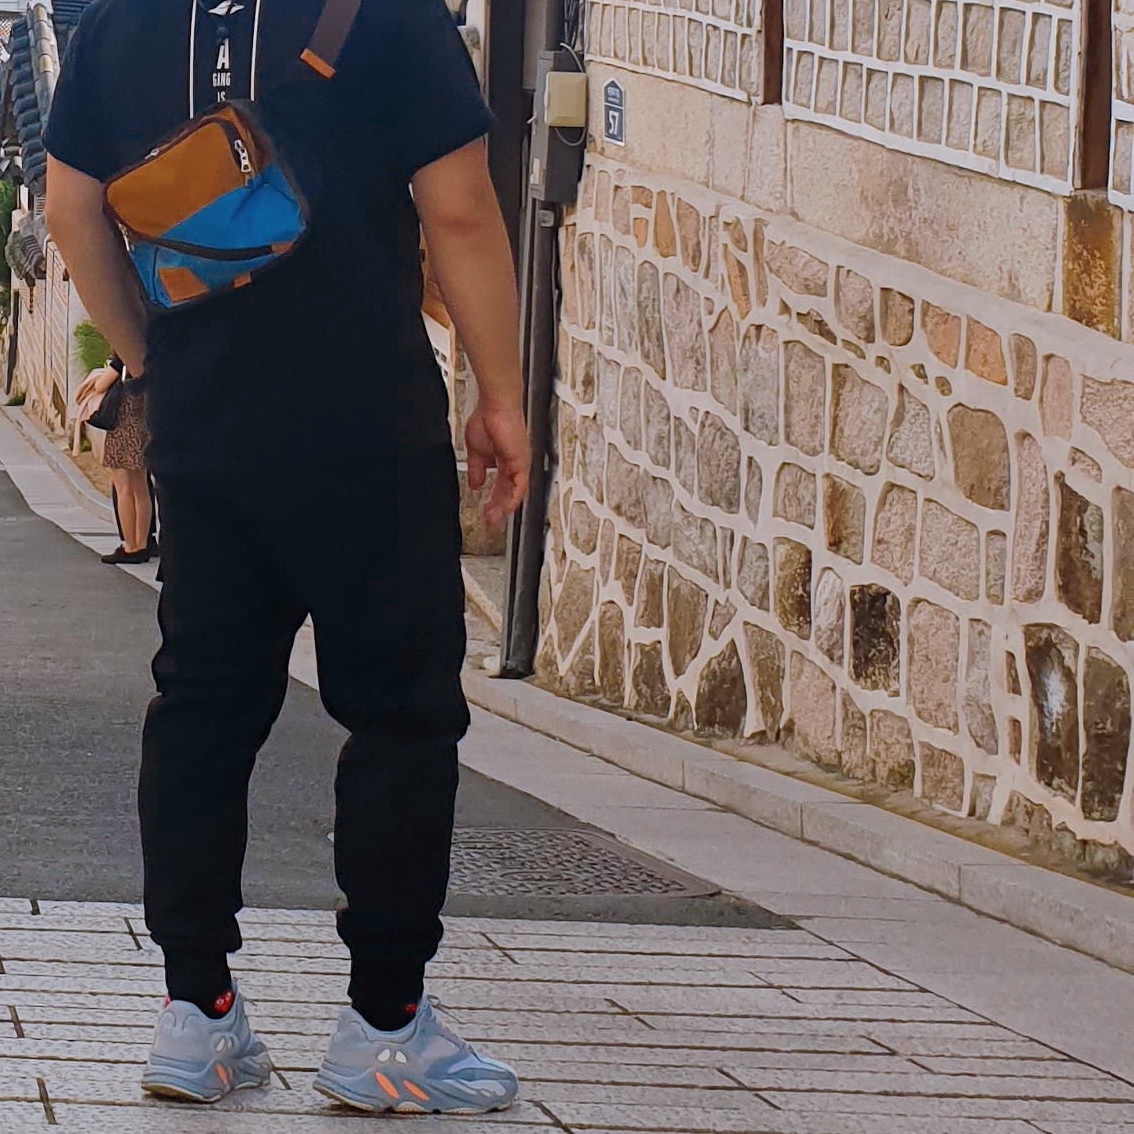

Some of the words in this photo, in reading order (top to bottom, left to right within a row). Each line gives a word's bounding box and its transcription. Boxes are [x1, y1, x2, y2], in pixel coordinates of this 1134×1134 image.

[216, 37, 230, 70] A
[212, 72, 231, 87] GANG
[608, 110, 620, 135] 57
